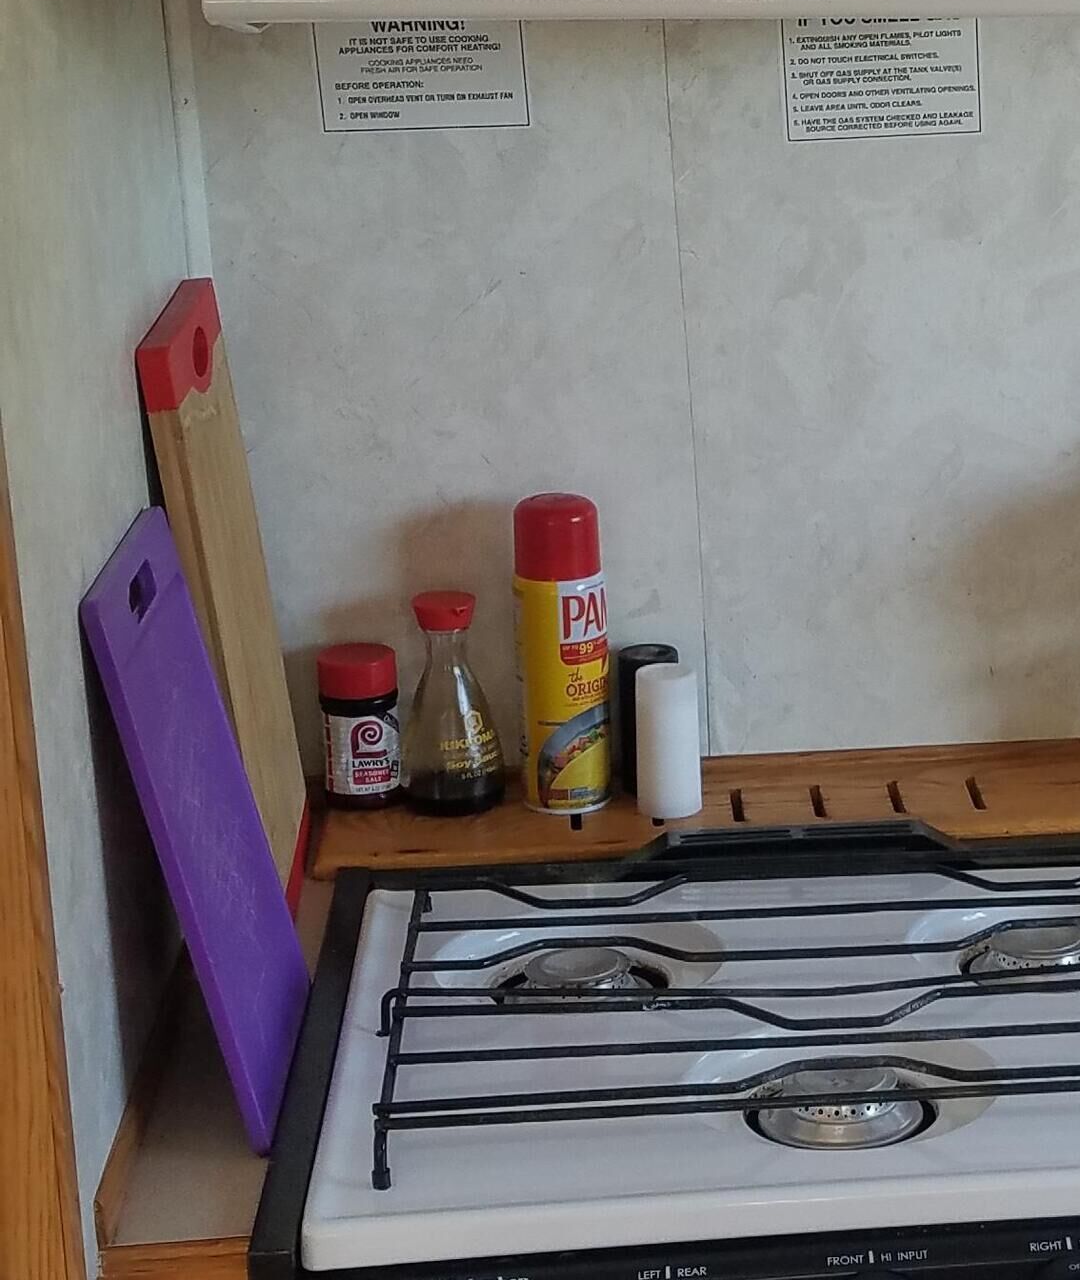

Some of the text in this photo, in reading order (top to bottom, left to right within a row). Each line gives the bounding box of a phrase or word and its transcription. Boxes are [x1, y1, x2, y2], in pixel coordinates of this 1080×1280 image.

[370, 37, 389, 46] NOT
[390, 36, 413, 45] SAFE
[415, 36, 428, 45] TO
[429, 36, 447, 44] USE
[449, 34, 489, 43] COOKING
[796, 35, 840, 44] EXTINGUISH
[858, 33, 879, 41] OPEN
[913, 30, 934, 38] PILOT
[935, 29, 962, 37] LIGHTS
[338, 45, 394, 55] APPLIANCES
[396, 45, 415, 54] FOR
[416, 43, 459, 53] COMFORT
[801, 43, 817, 51] AND
[833, 41, 868, 50] SMOKING
[854, 53, 899, 62] ELECTRICAL
[799, 71, 819, 79] SHUT
[820, 70, 835, 78] OFF
[853, 68, 881, 76] SUPPLY
[882, 67, 892, 75] AT
[893, 66, 908, 74] THE
[335, 80, 425, 91] BEFORE OPERATION:
[832, 77, 861, 85] SUPPLY
[348, 96, 368, 104] OPEN
[368, 95, 405, 104] OVERHEAD
[406, 94, 424, 103] VENT
[425, 94, 436, 102] OR
[437, 93, 456, 102] TURN
[457, 93, 467, 101] ON
[468, 92, 499, 101] EXHAUST
[500, 91, 513, 100] FAN
[800, 92, 820, 100] OPEN
[865, 88, 890, 96] OTHER
[891, 86, 937, 95] VENTILATING
[800, 104, 824, 112] LEAVE
[825, 103, 846, 111] AREA
[847, 102, 869, 110] UNTIL
[870, 101, 891, 109] ODOR
[350, 111, 369, 120] OPEN
[370, 110, 400, 119] WINDOW
[801, 118, 821, 126] HAVE
[855, 115, 885, 123] SYSTEM
[885, 113, 921, 121] CHECKED
[939, 111, 974, 120] LEAKAGE
[837, 122, 883, 132] CORRECTED
[884, 121, 913, 129] BEFORE
[914, 120, 937, 128] USING
[352, 757, 391, 768] LAWRY'S
[1029, 1240, 1062, 1252] RIGHT
[827, 1249, 928, 1267] FRONT HI INPUT
[638, 1266, 707, 1280] LEFT REAR
